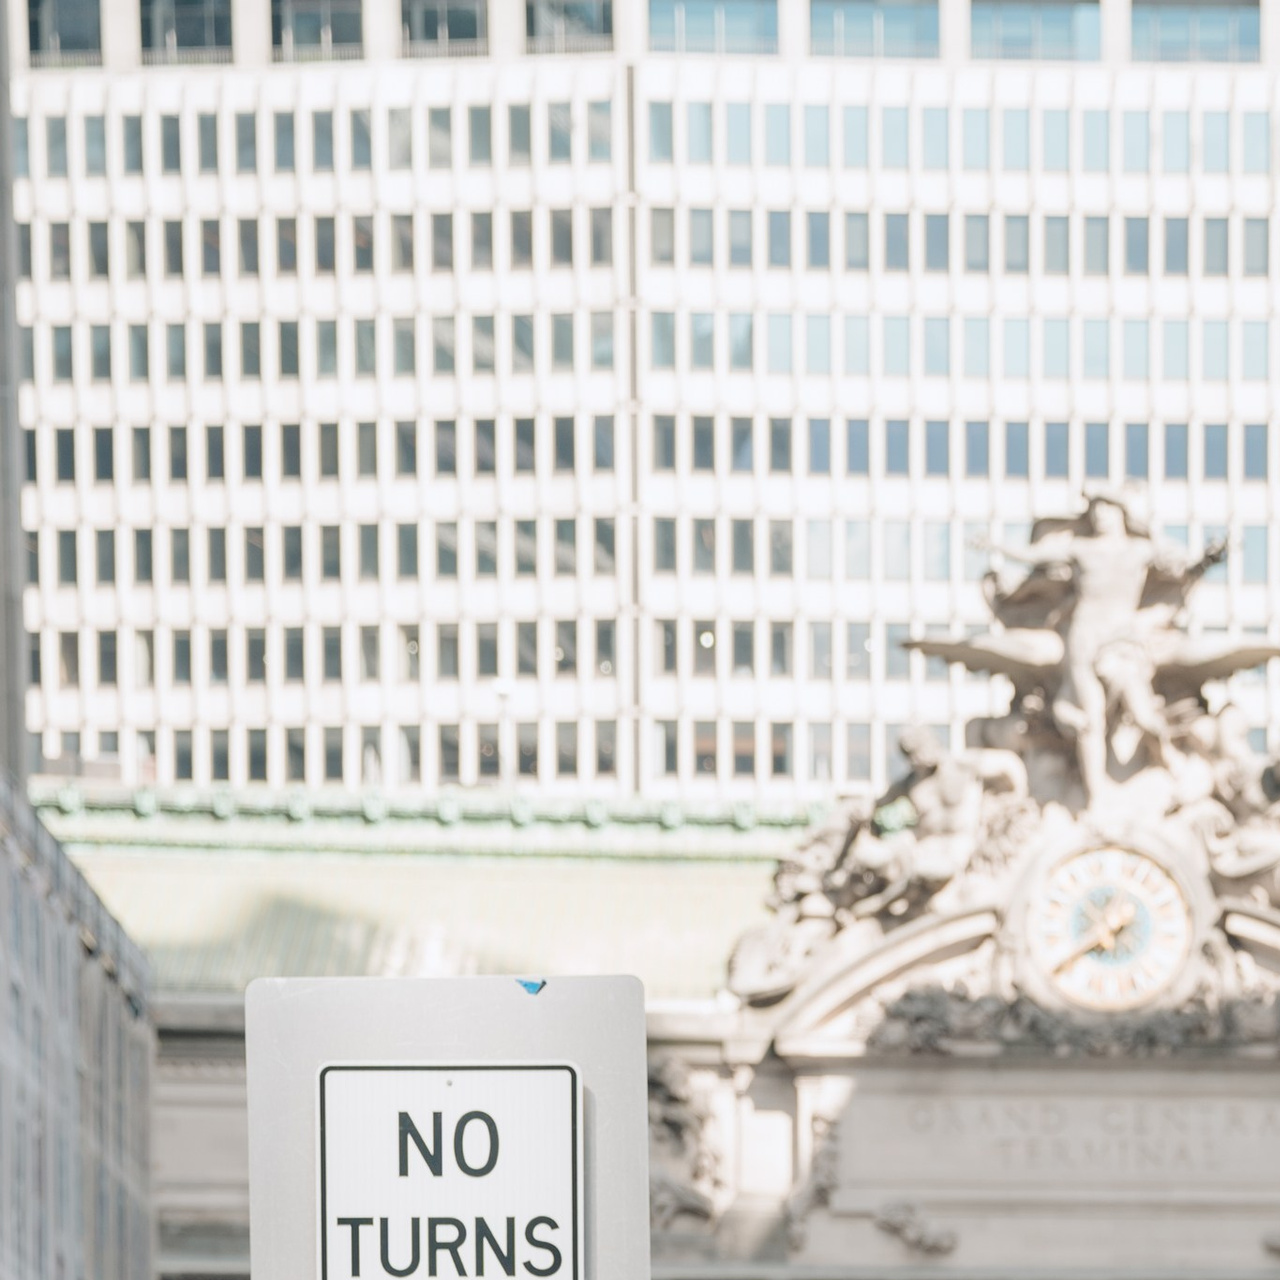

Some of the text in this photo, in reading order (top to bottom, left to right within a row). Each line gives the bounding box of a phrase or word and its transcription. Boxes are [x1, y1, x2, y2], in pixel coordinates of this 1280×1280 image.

[906, 1101, 1069, 1135] GRAND
[398, 1111, 499, 1178] NO
[995, 1138, 1225, 1172] TERMINAL
[337, 1216, 562, 1277] TURNS
